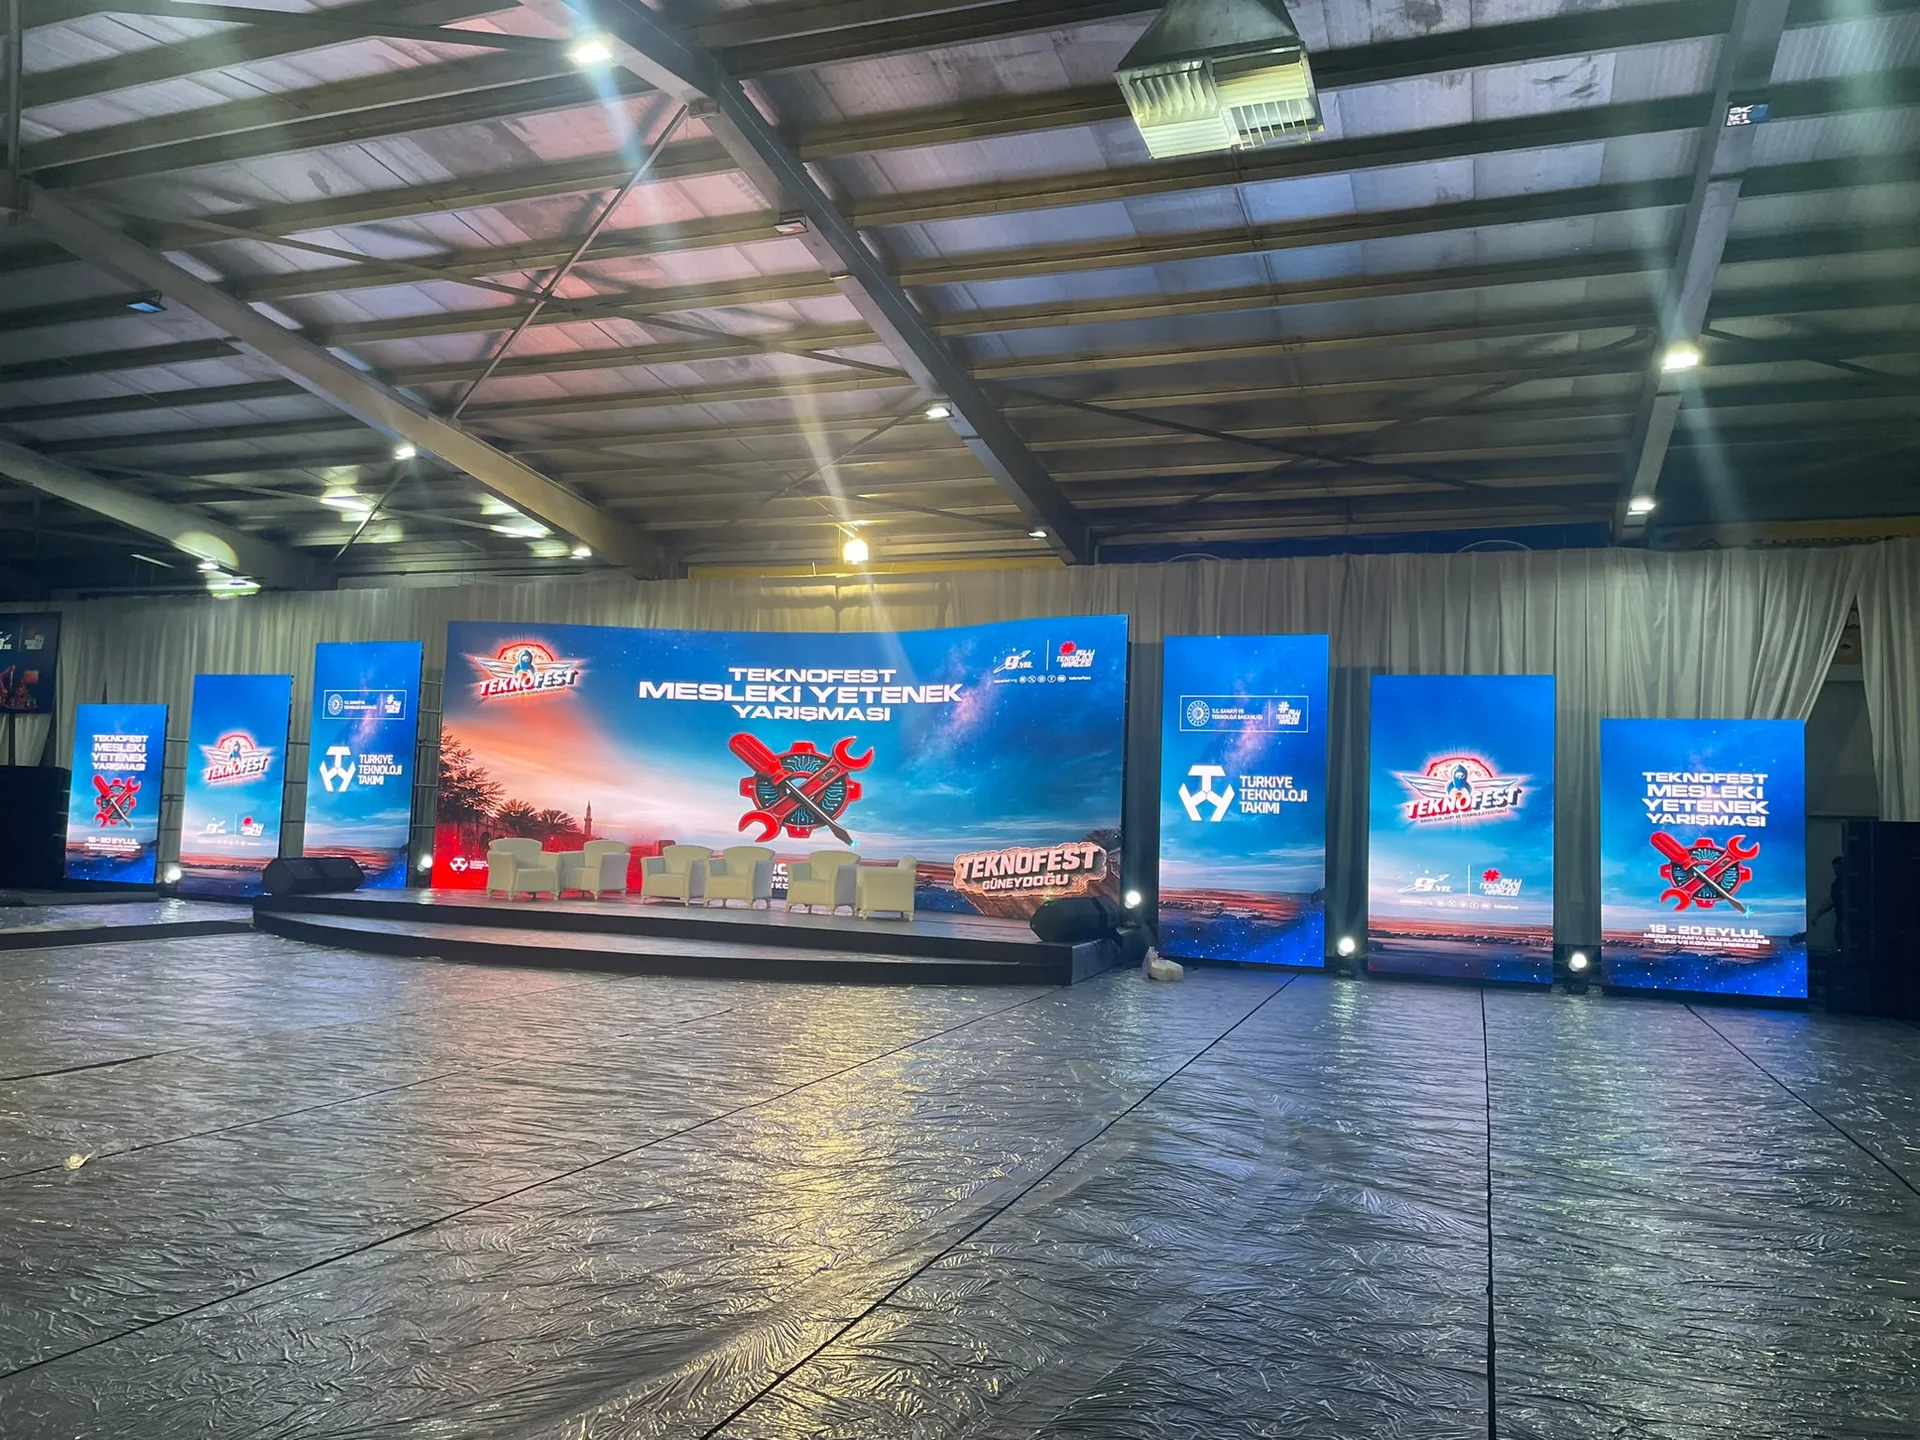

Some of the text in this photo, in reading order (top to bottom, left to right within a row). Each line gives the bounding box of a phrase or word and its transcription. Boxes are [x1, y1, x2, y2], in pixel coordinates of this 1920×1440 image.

[479, 669, 579, 697] TEKNOFEST
[728, 667, 896, 683] TEKNOFEST
[808, 683, 964, 704] YETENEK
[731, 704, 892, 721] YARIŞMASI
[92, 734, 149, 743] TEKNOFEST
[91, 752, 147, 763] YETENEK
[205, 757, 269, 781] TEKNOFEST
[358, 775, 384, 785] TAKIMI
[1642, 771, 1769, 784] TEKNOFEST
[1239, 801, 1280, 814] TAKIMI
[1406, 788, 1522, 819] TEKNOFEST
[1642, 798, 1770, 814] YETENEK
[958, 847, 1100, 879] TEKNOFEST
[982, 872, 1069, 890] GÜNEYDOĞU
[1648, 924, 1667, 934] 18
[1678, 925, 1703, 935] 20
